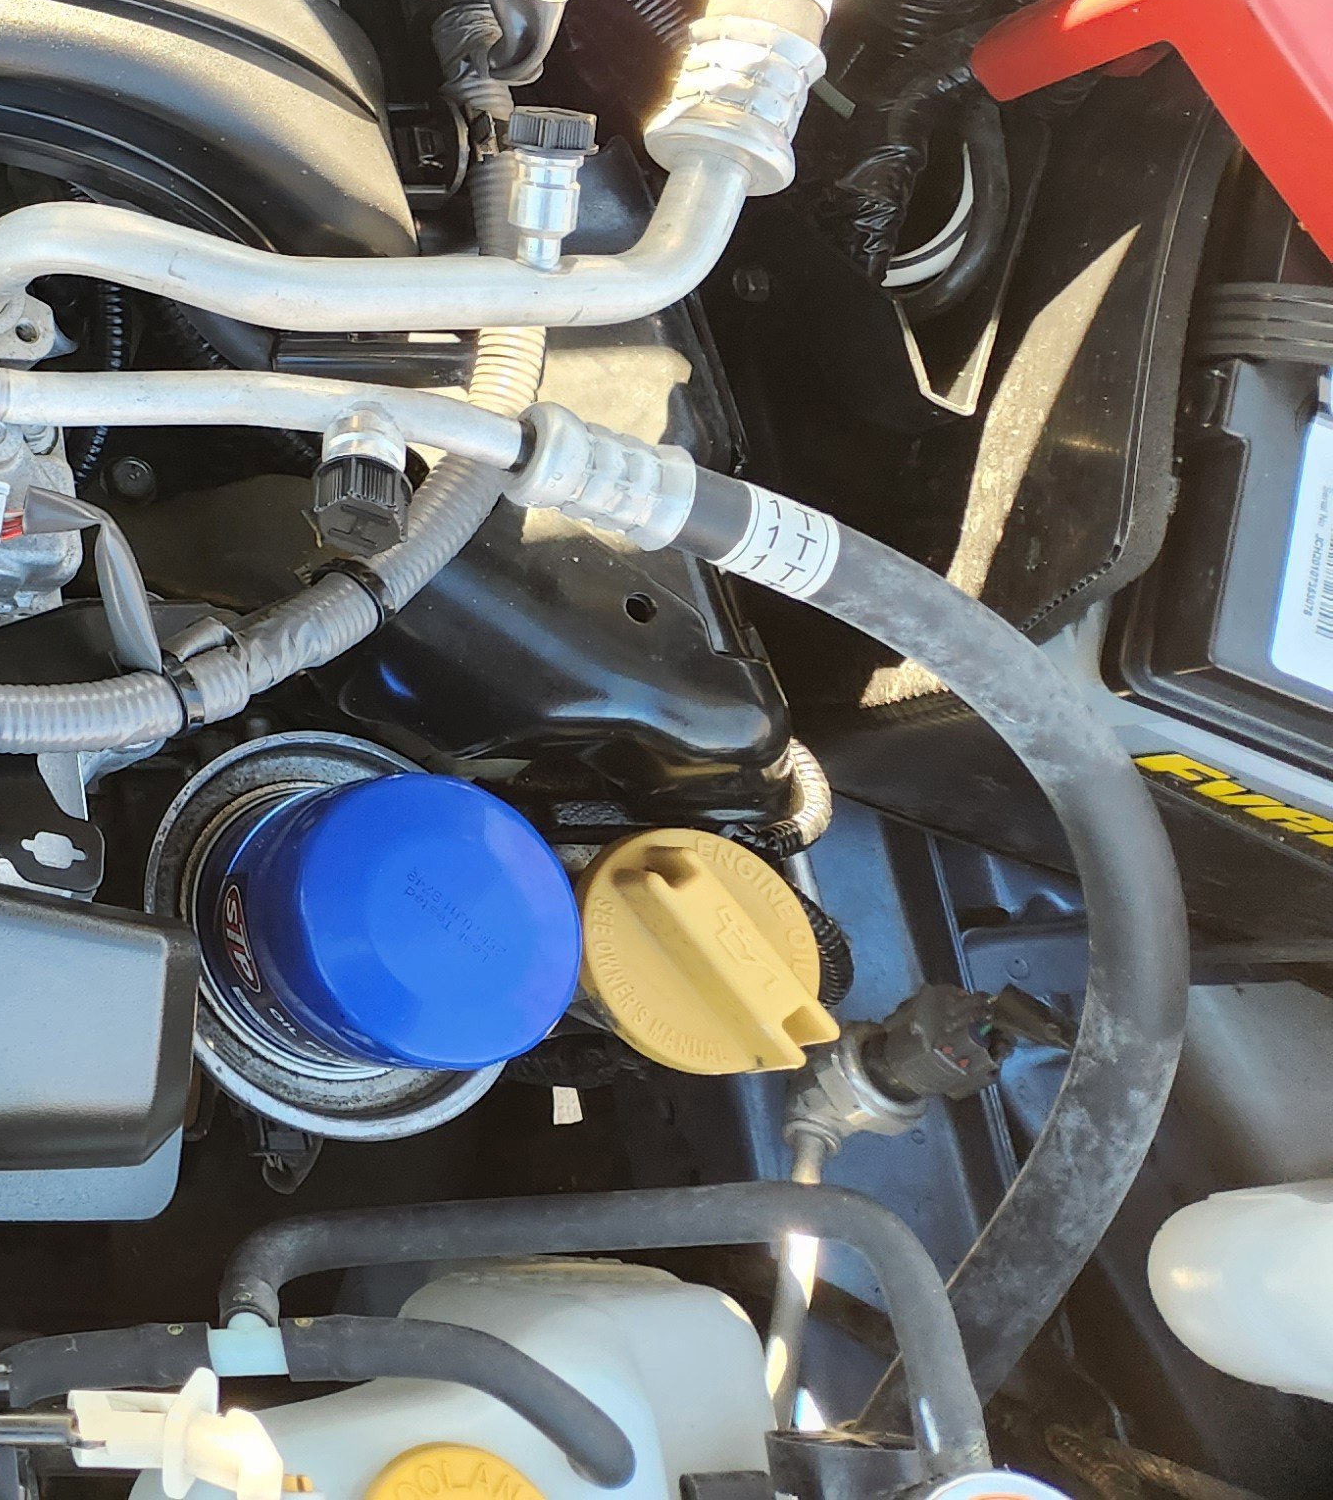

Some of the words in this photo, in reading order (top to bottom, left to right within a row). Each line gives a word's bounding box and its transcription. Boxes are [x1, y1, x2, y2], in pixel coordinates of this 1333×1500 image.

[224, 895, 258, 983] STP
[592, 896, 616, 937] SEE
[694, 836, 797, 923] ENGINE
[784, 928, 813, 975] OIL
[595, 938, 650, 1025] OWNER'S
[268, 1005, 298, 1037] OIL
[647, 1016, 732, 1067] MANUAL
